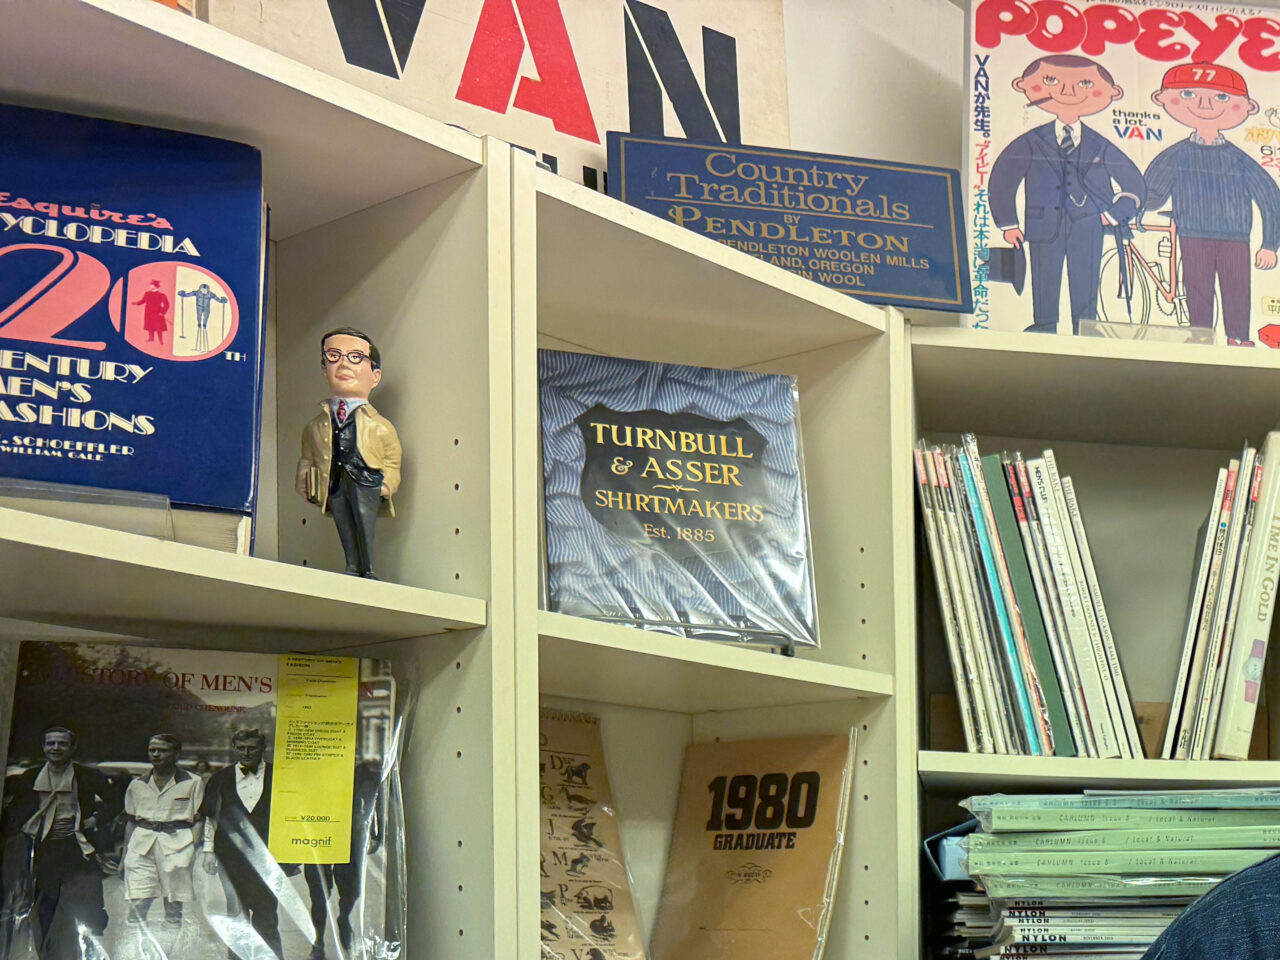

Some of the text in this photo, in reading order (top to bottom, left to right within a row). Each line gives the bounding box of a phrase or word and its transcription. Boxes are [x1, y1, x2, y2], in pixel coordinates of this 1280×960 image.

[1192, 69, 1216, 82] 77
[1112, 109, 1160, 120] thanks
[1114, 126, 1163, 142] VAN
[705, 152, 868, 196] Country
[666, 172, 911, 221] Traditionals
[668, 205, 910, 252] PENDLETON
[784, 214, 800, 224] BY
[809, 259, 875, 276] OREGON
[815, 249, 880, 264] WOOLEN
[886, 256, 930, 270] MILLS
[819, 272, 865, 287] WOOL
[12, 435, 135, 456] SCHOEFFLER
[590, 422, 753, 459] TURNBULL
[71, 452, 104, 462] GALE
[611, 457, 743, 487] & ASSER
[595, 489, 765, 522] SHIRTMAKERS
[644, 524, 715, 542] Est. 1885
[1265, 554, 1276, 574] IN
[1256, 577, 1275, 623] GOLD
[163, 670, 195, 691] OF
[200, 673, 273, 694] MEN'S
[706, 771, 820, 831] 1980
[292, 836, 332, 848] magnif
[714, 832, 796, 850] GRADUATE
[1022, 934, 1067, 942] NYLON
[1004, 945, 1047, 953] NYLON
